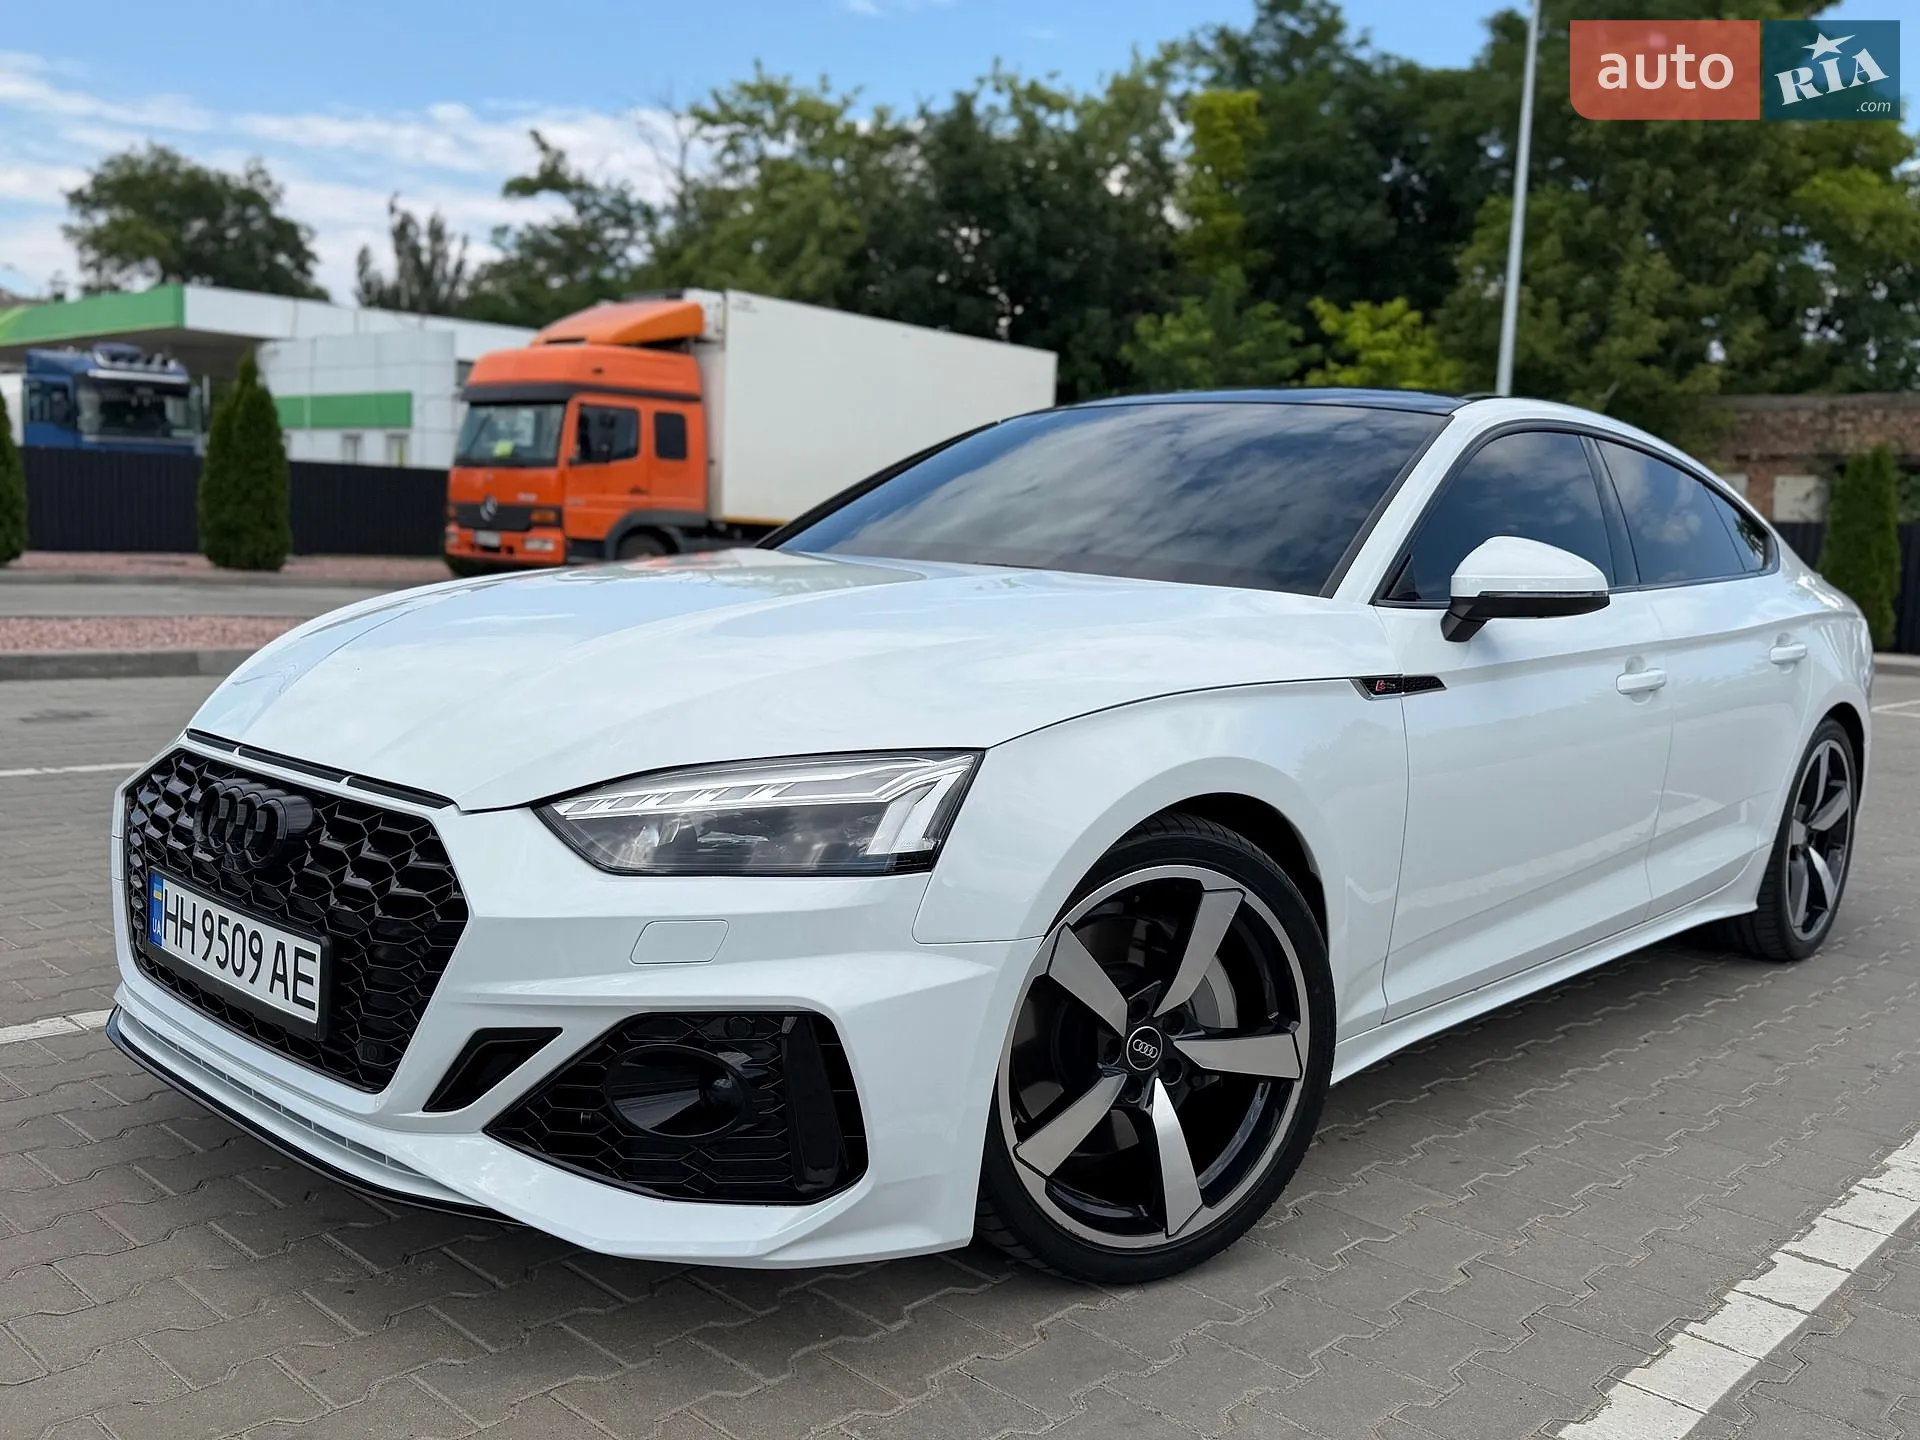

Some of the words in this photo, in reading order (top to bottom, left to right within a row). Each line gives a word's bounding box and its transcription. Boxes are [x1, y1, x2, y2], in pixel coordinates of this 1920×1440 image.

[152, 918, 162, 937] UA
[202, 908, 263, 985] 9509
[269, 940, 317, 1011] AE
